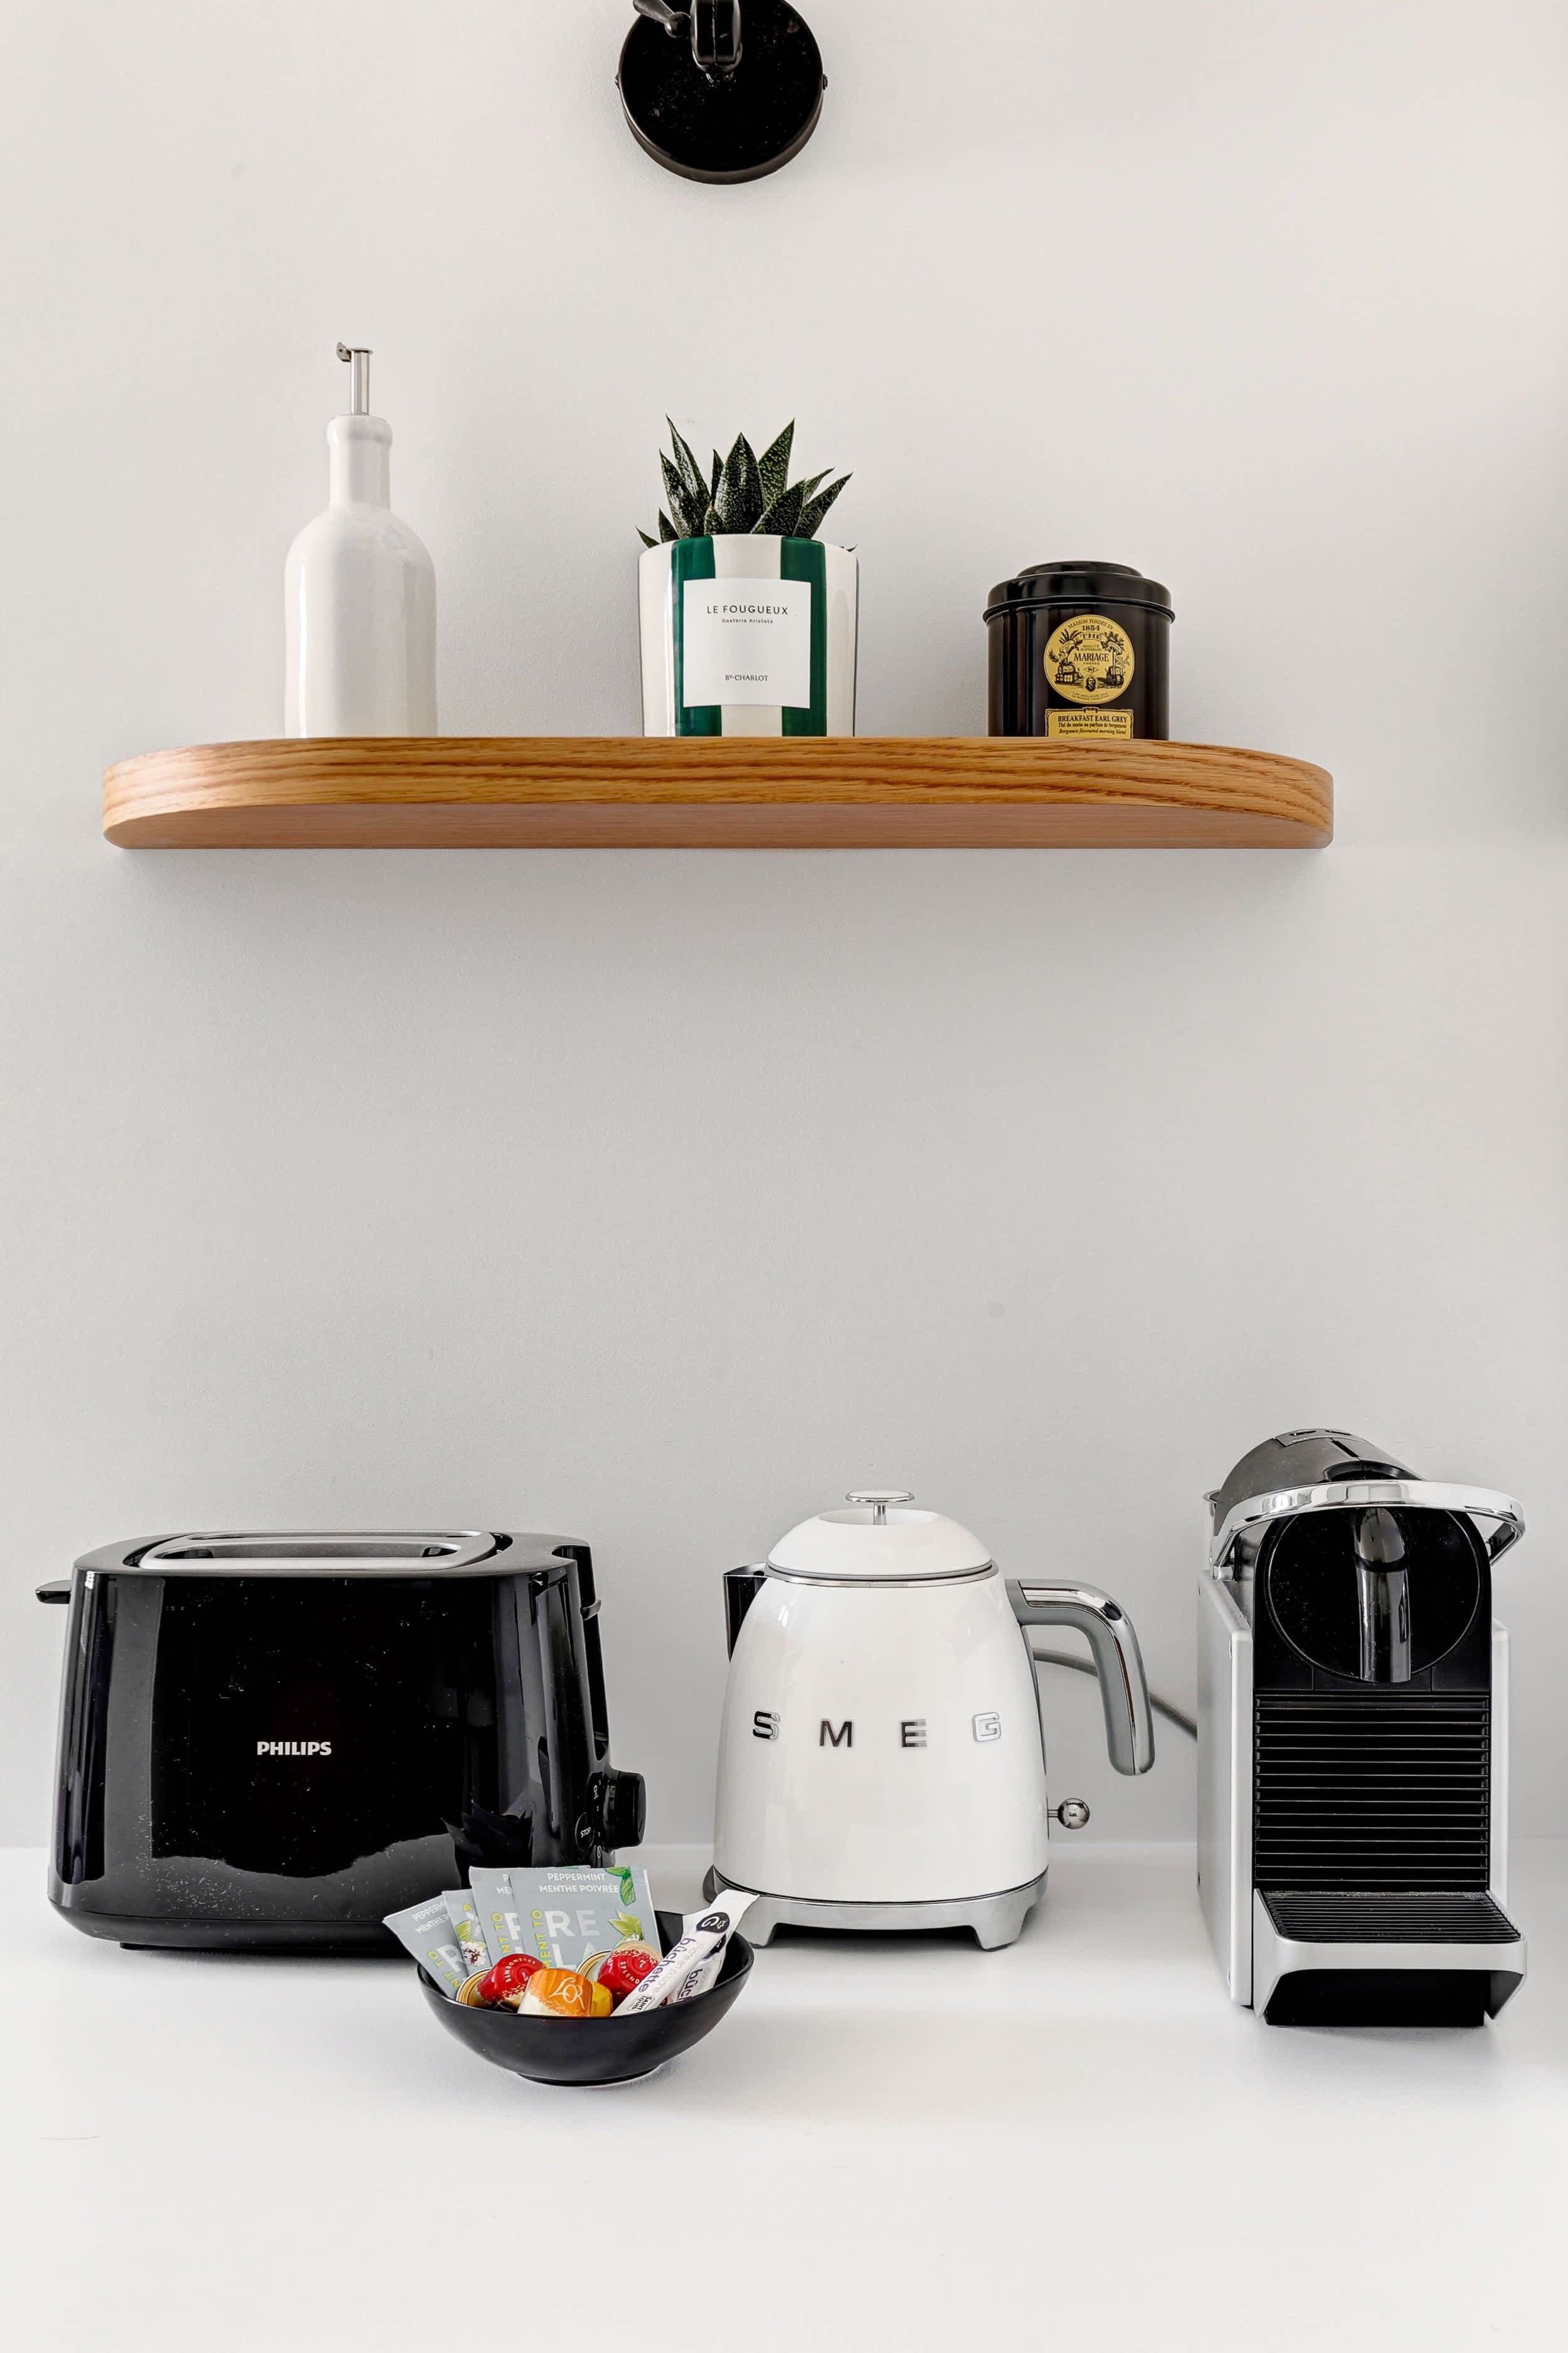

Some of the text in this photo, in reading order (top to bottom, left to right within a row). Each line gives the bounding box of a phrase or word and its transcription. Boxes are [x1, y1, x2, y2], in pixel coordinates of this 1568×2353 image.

[707, 605, 788, 615] LE FOUGUEUX
[1068, 619, 1088, 628] MAISON
[1073, 652, 1110, 662] MARIAGE
[752, 1710, 1002, 1748] SMEG
[257, 1741, 332, 1756] PHILIPS
[581, 1827, 592, 1837] STOP
[548, 1872, 605, 1881] PEPPERMINT
[539, 1883, 620, 1893] MENTHE POIVRÉE
[491, 1911, 506, 1931] TO
[531, 1909, 544, 1928] TO
[544, 1909, 600, 1938] RE
[639, 1959, 647, 1968] 7
[637, 1997, 652, 2011] SAINT
